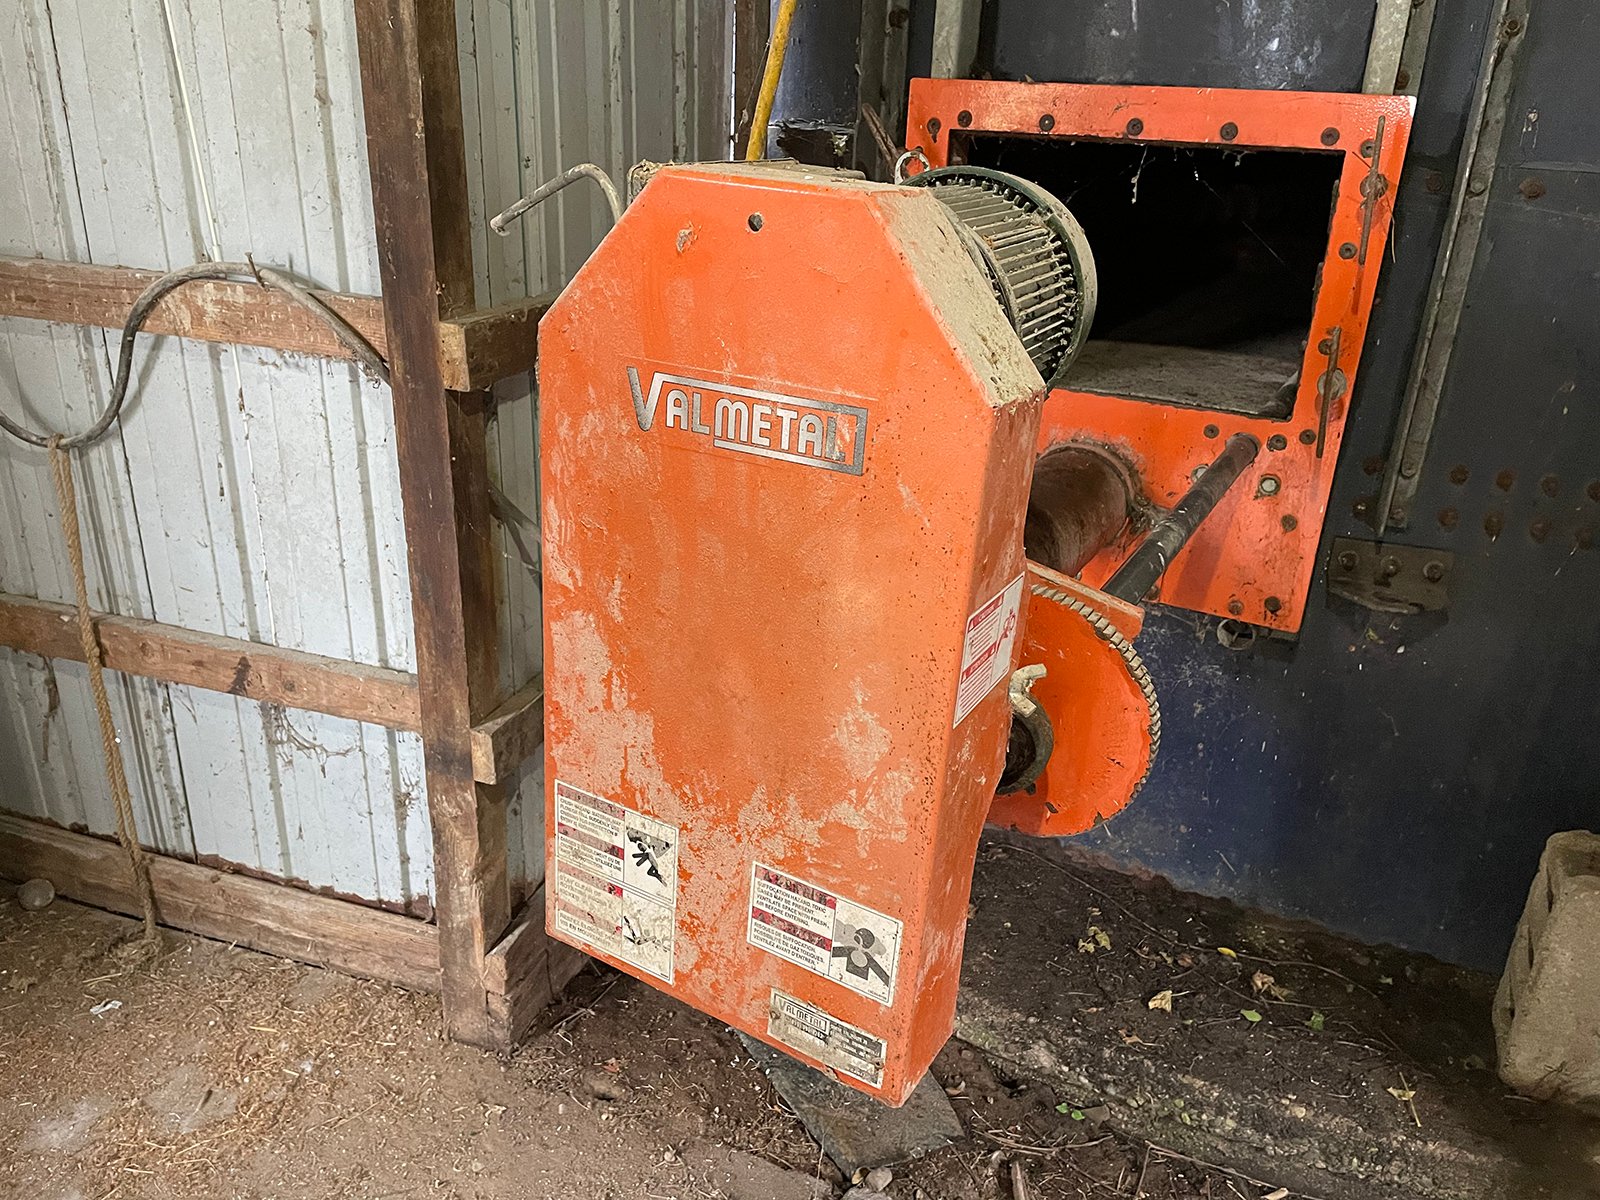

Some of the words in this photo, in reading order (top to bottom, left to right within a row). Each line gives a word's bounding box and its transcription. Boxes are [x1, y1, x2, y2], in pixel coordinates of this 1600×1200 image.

[626, 366, 850, 466] VALMETAL
[756, 886, 772, 897] GASES
[773, 893, 783, 902] MAY
[757, 880, 790, 898] SUFFOCATION
[811, 903, 826, 913] TOXIC
[757, 893, 780, 907] VENTILATE
[781, 903, 797, 914] SPACE
[797, 910, 810, 920] WITH
[765, 902, 783, 915] BEFORE
[569, 922, 576, 930] EN
[753, 933, 775, 947] VENTILEZ
[775, 943, 790, 954] AVANT
[782, 939, 788, 947] DE
[789, 943, 799, 952] GAZ
[776, 997, 823, 1029] VALMETAL
